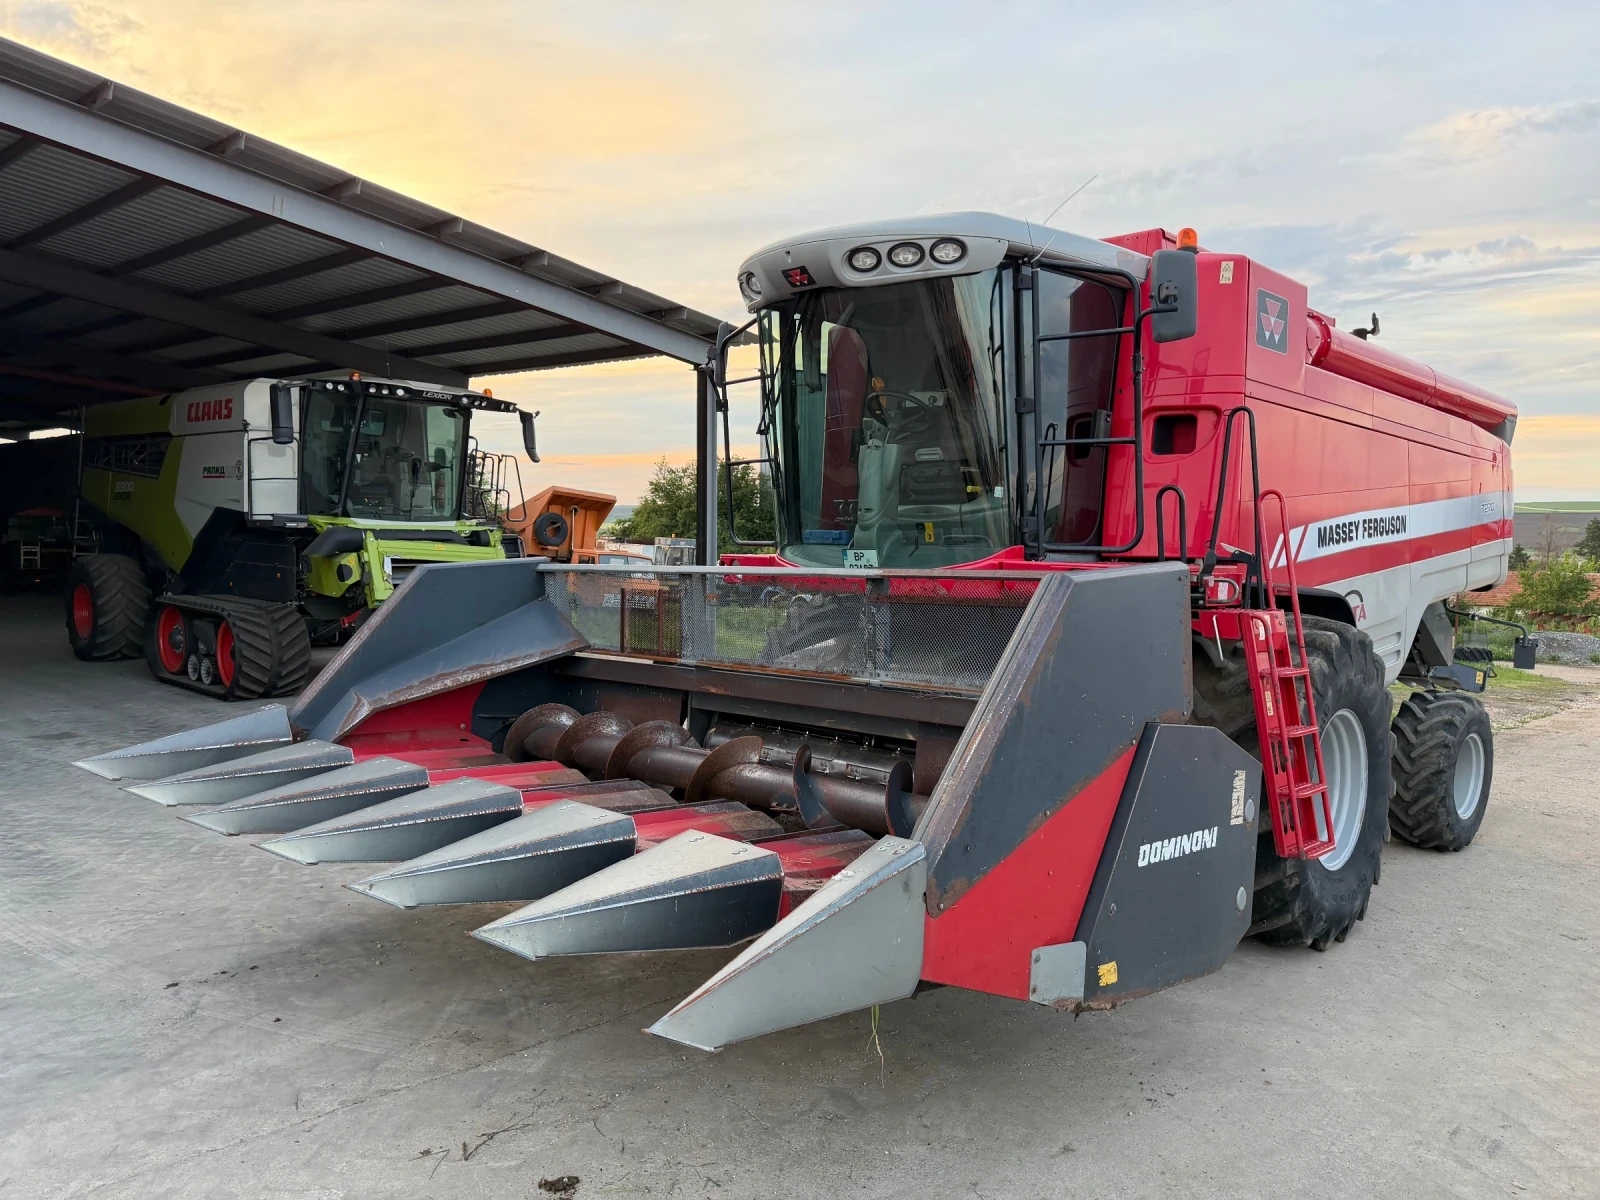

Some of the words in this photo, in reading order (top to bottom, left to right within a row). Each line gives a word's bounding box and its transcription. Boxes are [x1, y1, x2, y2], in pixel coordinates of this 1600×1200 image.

[422, 391, 453, 400] LEXION
[187, 398, 233, 422] CLAAS
[1317, 519, 1360, 549] MASSEY
[1362, 515, 1407, 539] FERGUSON
[1351, 603, 1367, 622] TA
[1137, 826, 1219, 868] DOMINONI
